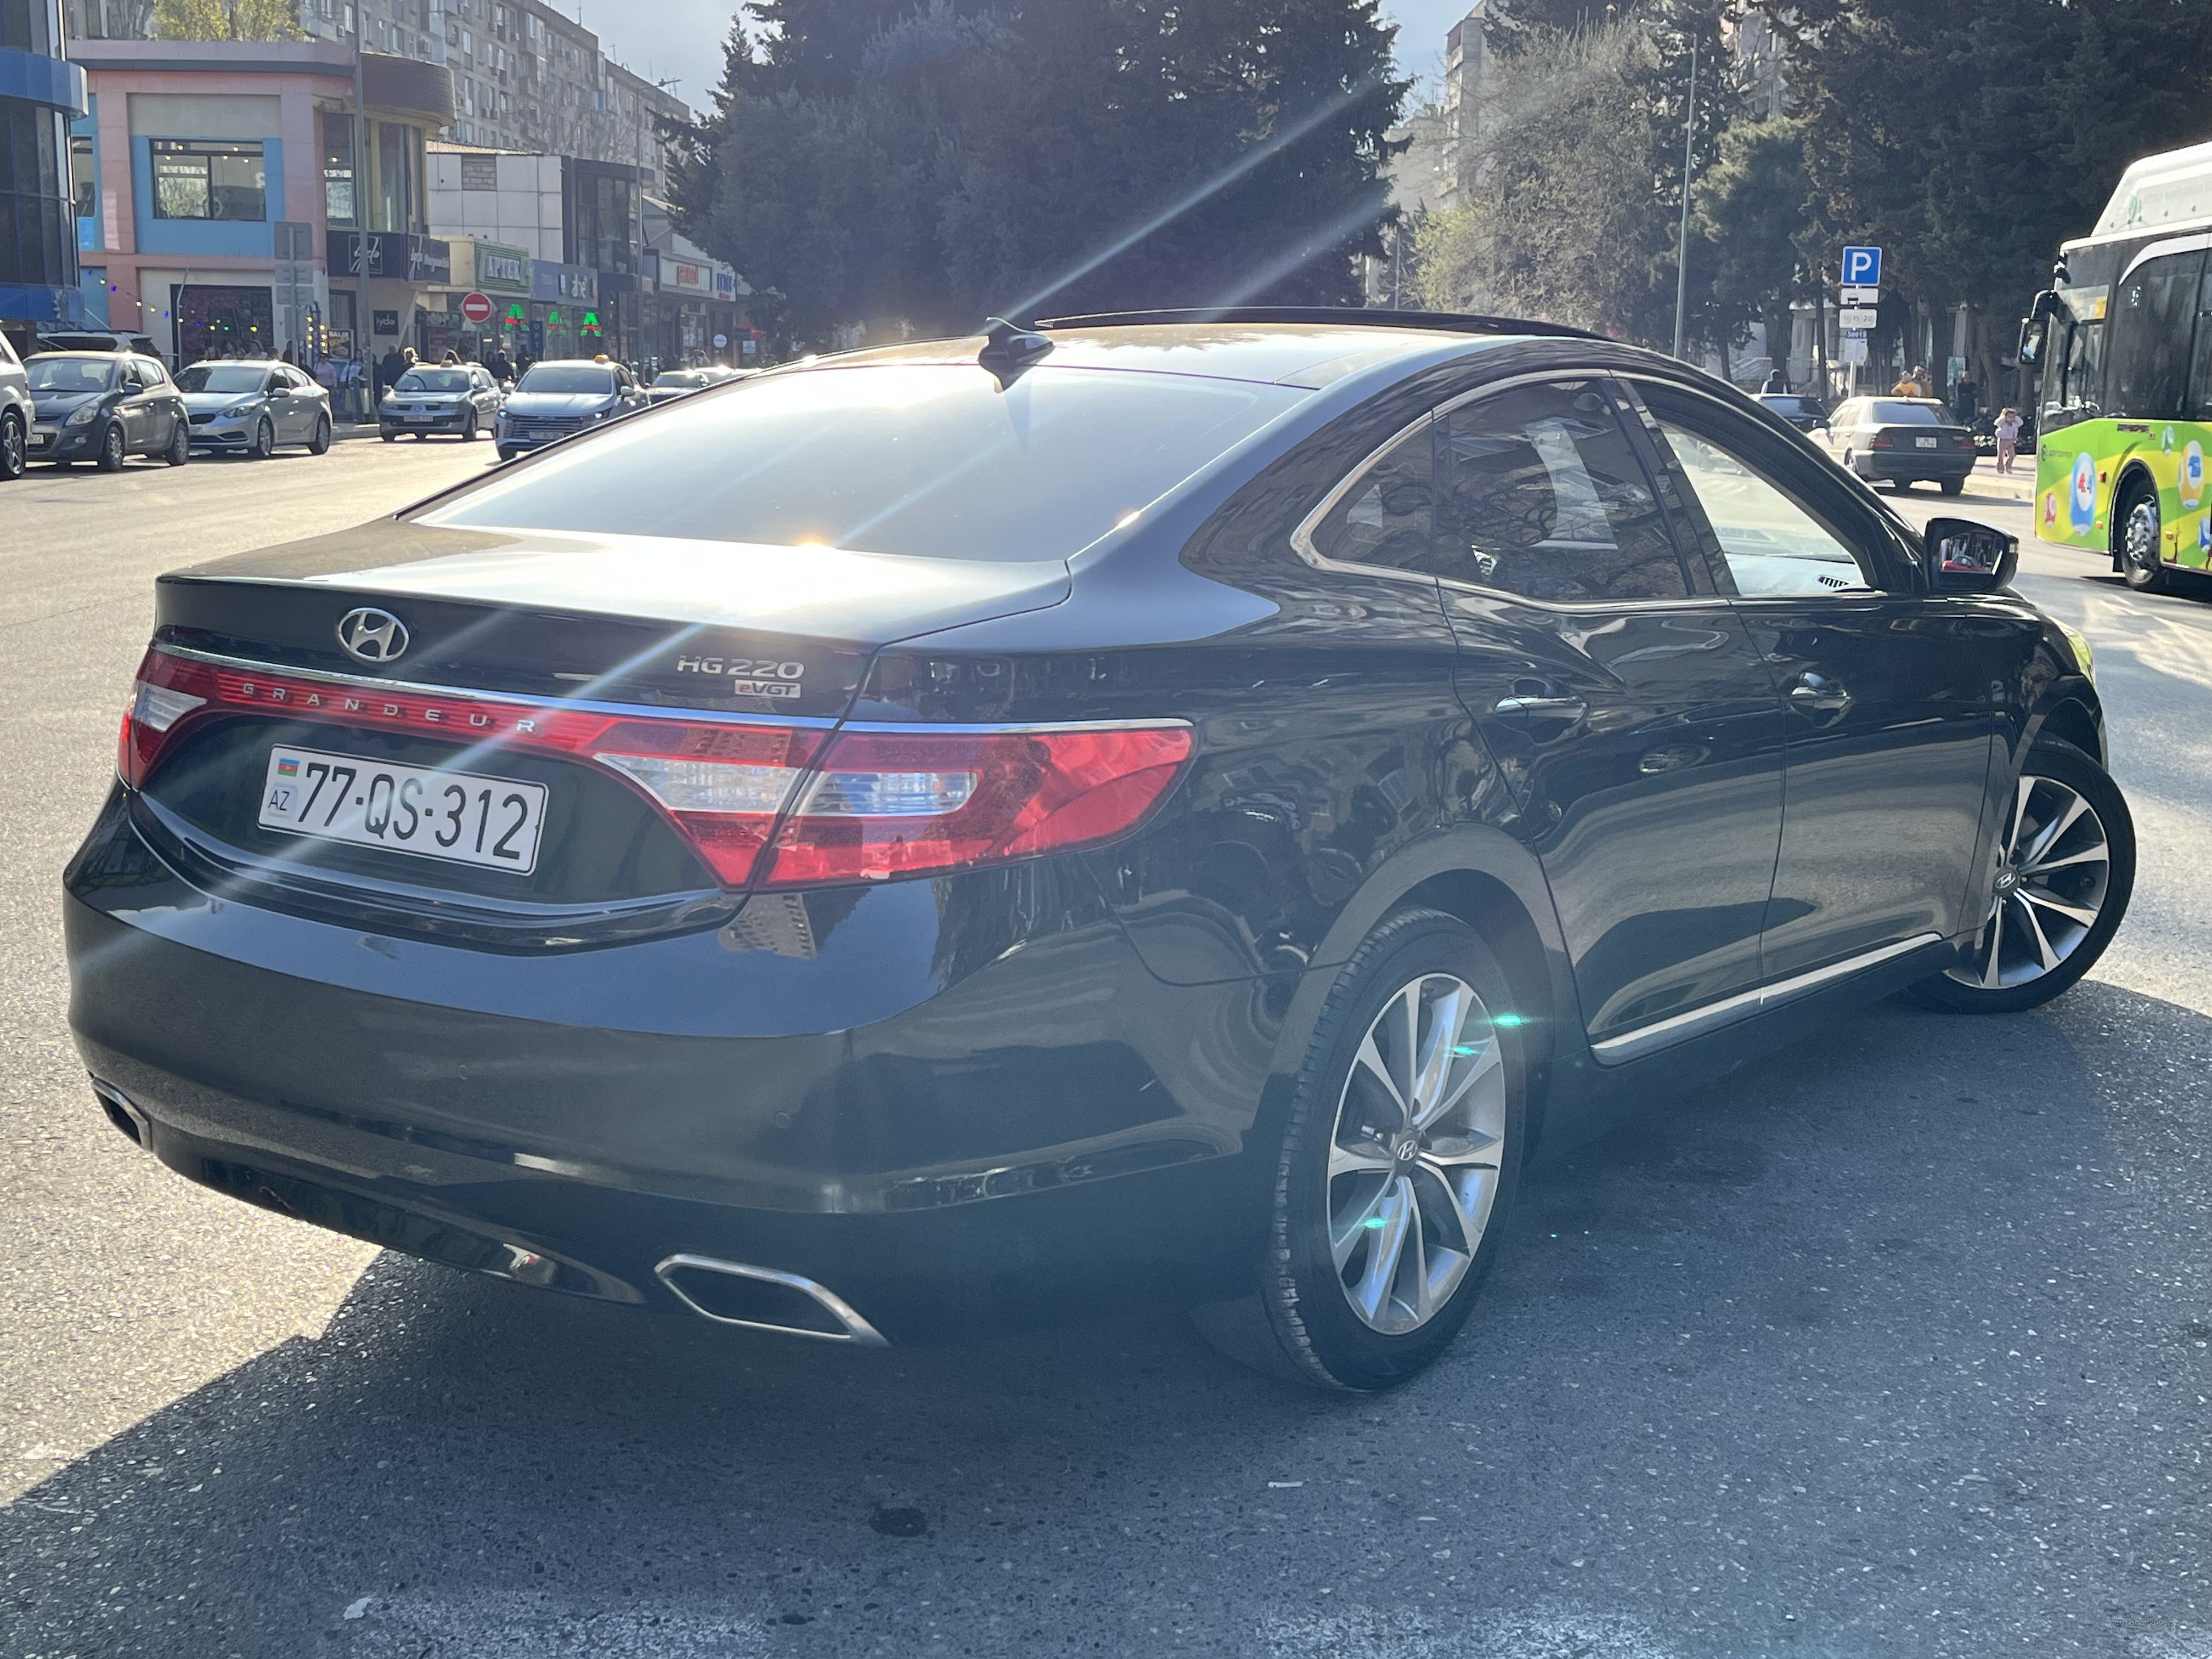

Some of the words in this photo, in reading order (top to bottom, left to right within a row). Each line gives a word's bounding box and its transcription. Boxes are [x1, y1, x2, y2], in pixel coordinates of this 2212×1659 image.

[486, 255, 521, 281] APTEK
[1850, 251, 1872, 281] P
[677, 655, 724, 674] HG
[727, 658, 805, 679] 220
[738, 682, 797, 696] eVGT
[242, 683, 536, 733] GRANDEUR
[268, 789, 290, 811] AZ
